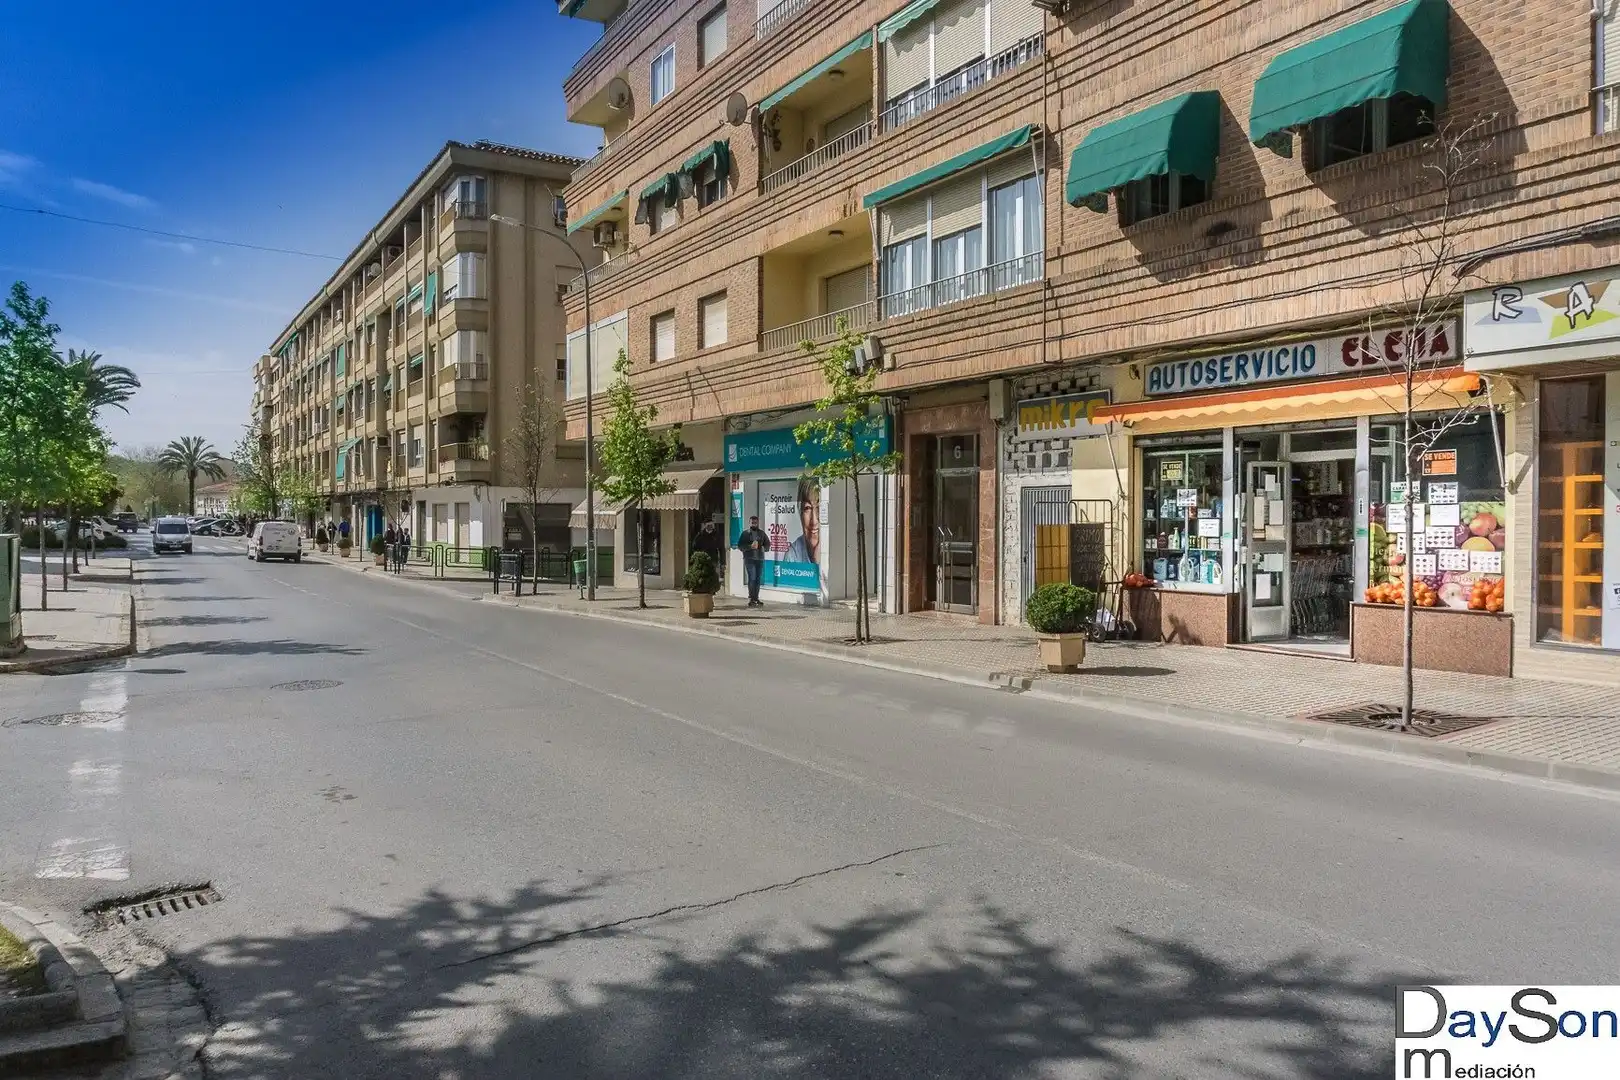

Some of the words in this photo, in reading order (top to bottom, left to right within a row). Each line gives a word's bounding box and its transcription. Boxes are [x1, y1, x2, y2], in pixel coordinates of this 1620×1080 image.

[1149, 344, 1316, 392] AUTOSERVICIO
[739, 446, 761, 457] DENTAL
[761, 443, 792, 456] COMPANY
[954, 445, 961, 459] 6
[1424, 453, 1433, 461] SE
[1433, 452, 1455, 460] VENDE
[777, 505, 795, 514] Salud
[768, 523, 788, 535] -20%
[781, 568, 795, 576] DENTAL
[795, 569, 814, 578] COMPANY
